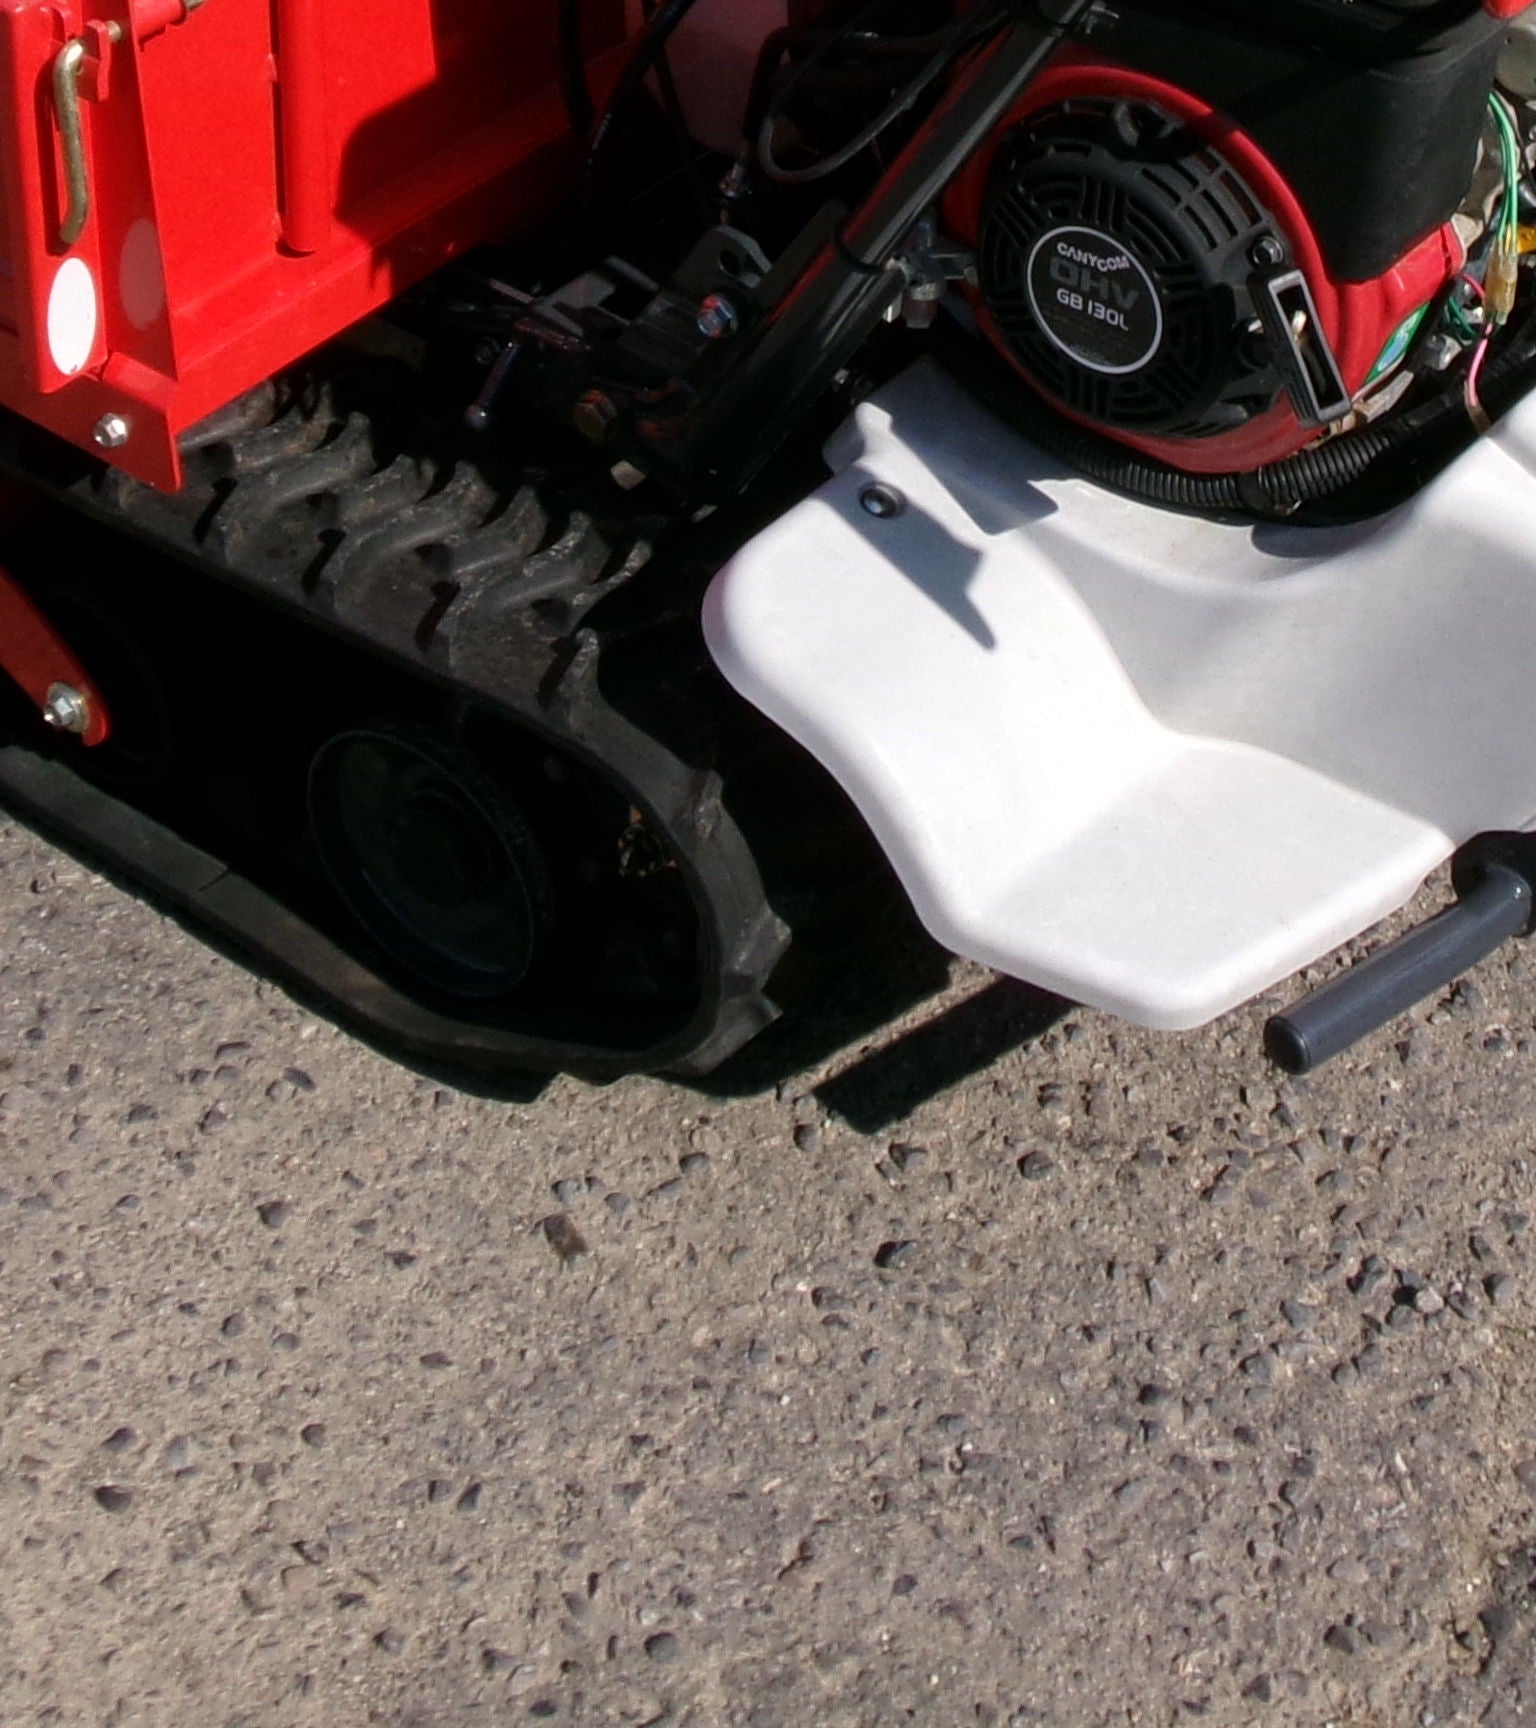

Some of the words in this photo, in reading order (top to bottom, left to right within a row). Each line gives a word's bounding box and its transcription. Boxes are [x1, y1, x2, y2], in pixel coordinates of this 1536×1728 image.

[1056, 241, 1130, 273] CANYCOM
[1056, 287, 1083, 311] GB
[1087, 299, 1129, 332] 130L
